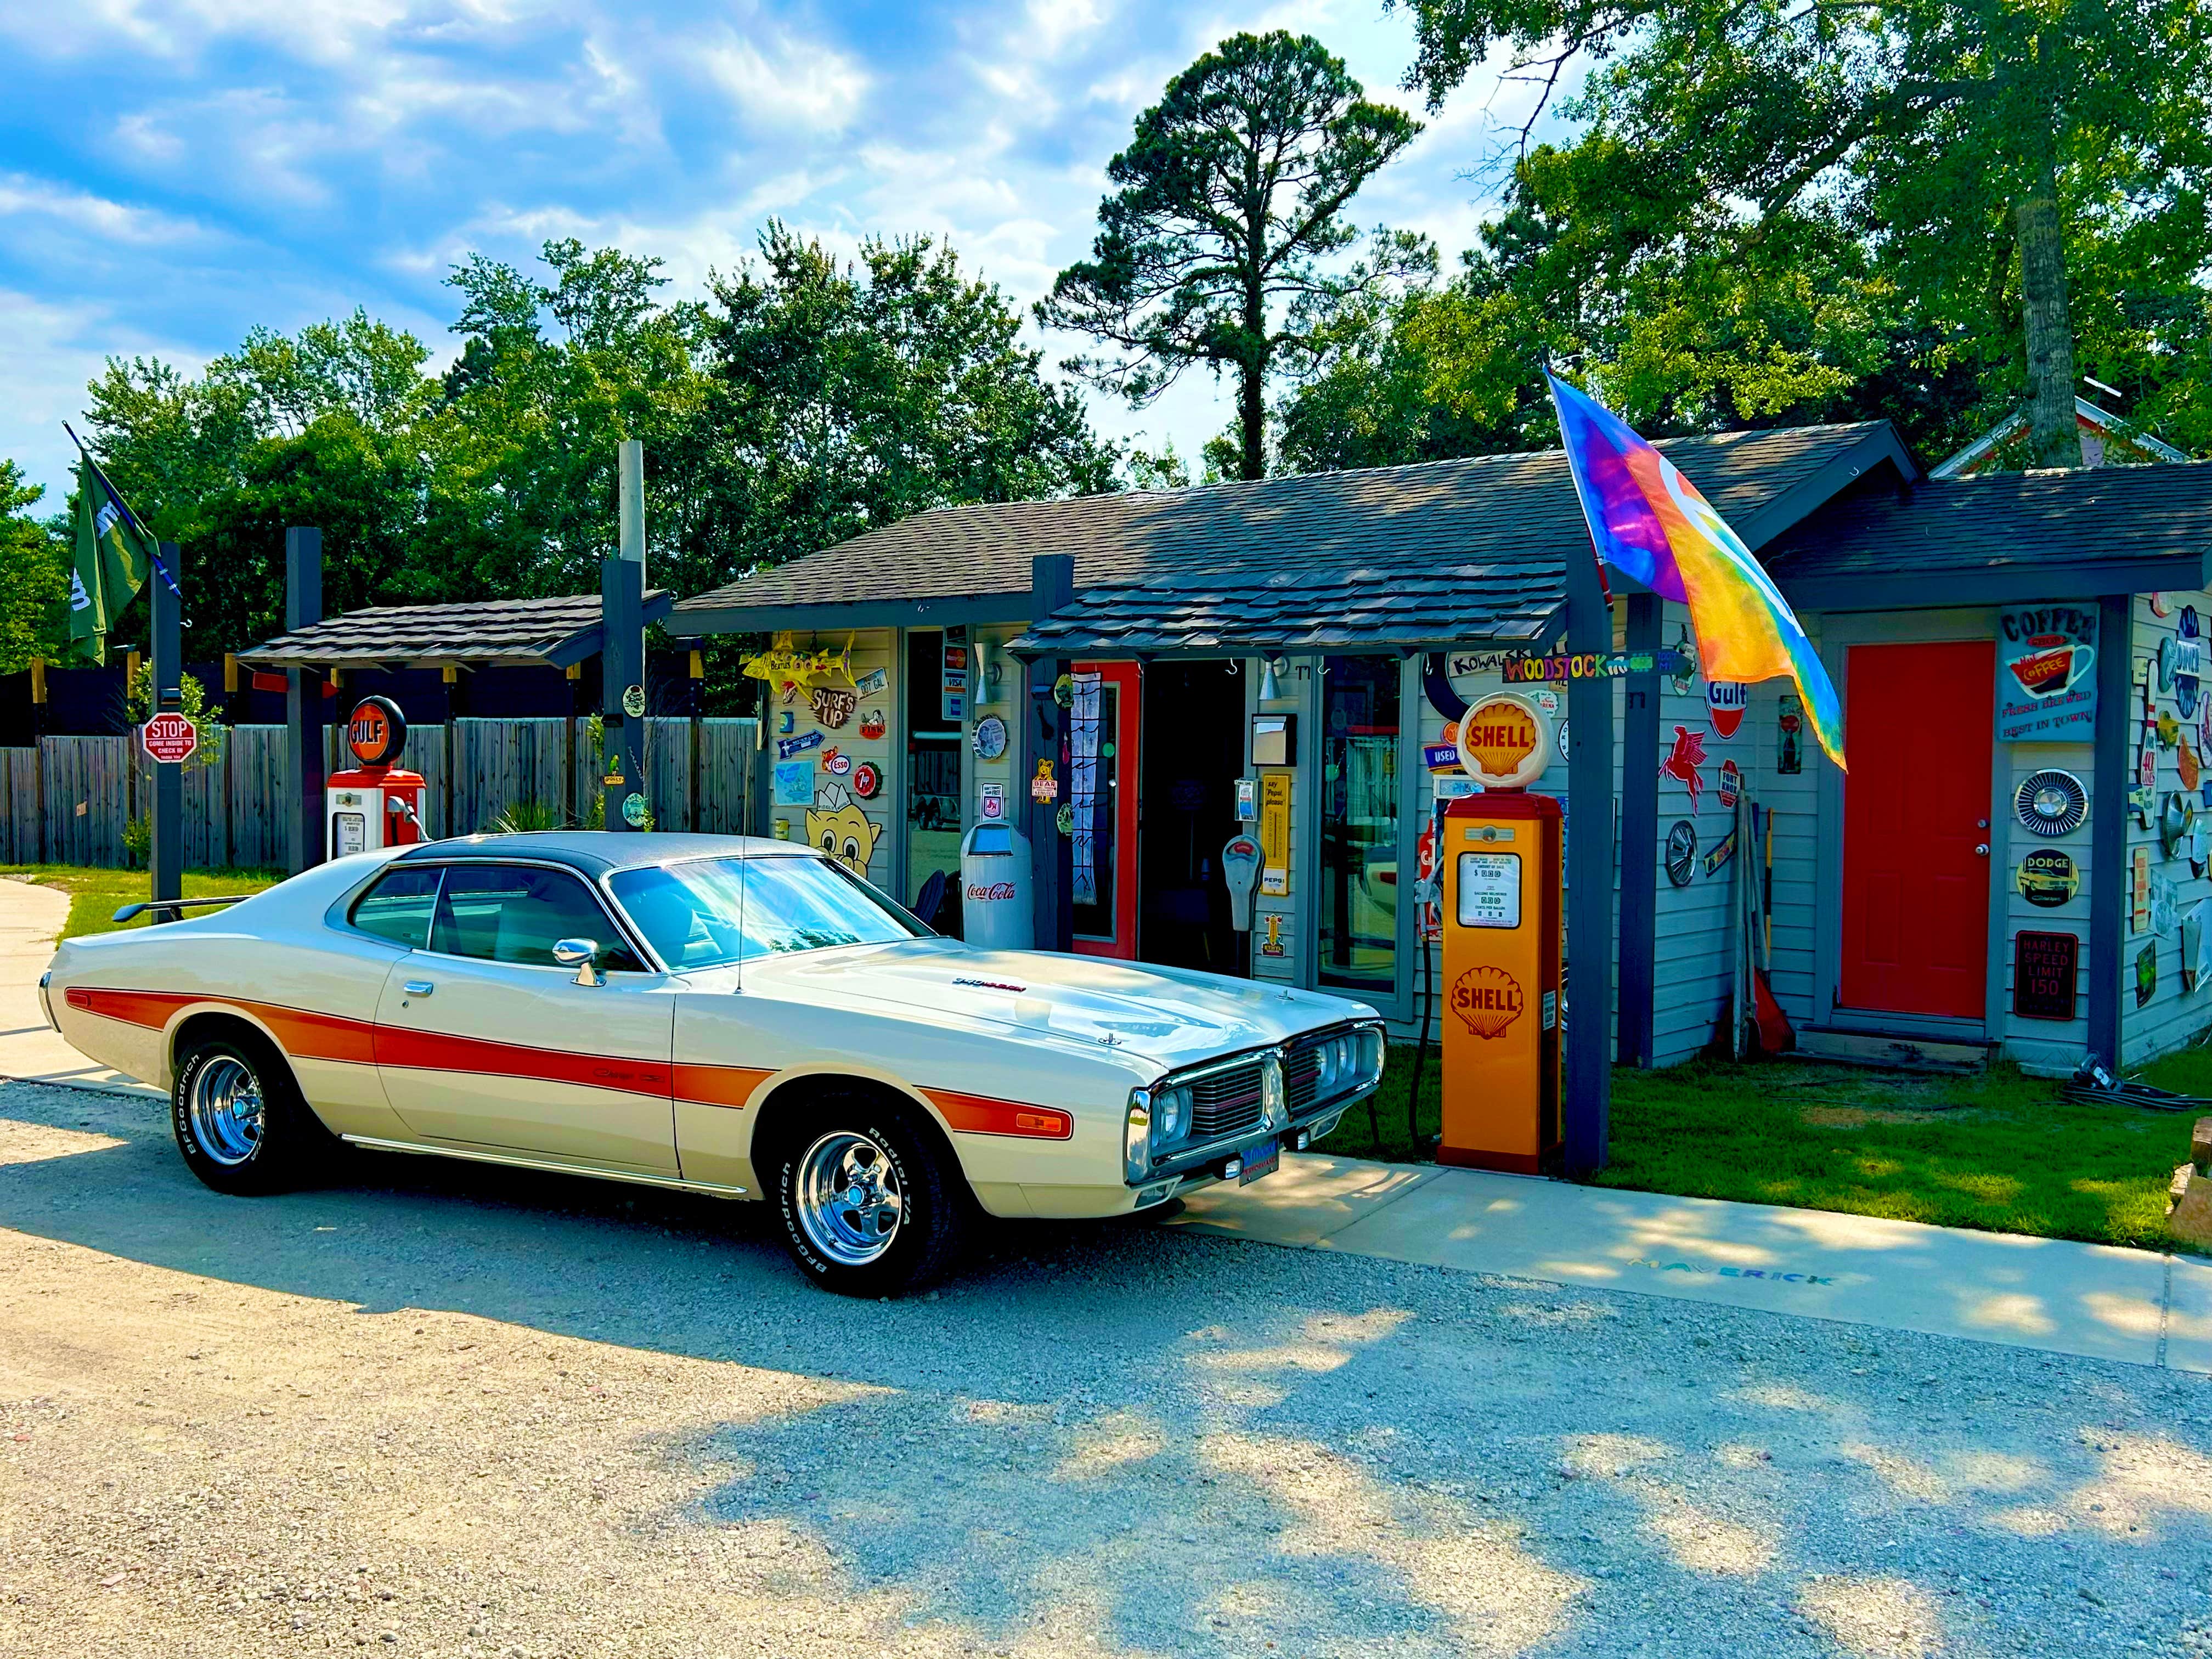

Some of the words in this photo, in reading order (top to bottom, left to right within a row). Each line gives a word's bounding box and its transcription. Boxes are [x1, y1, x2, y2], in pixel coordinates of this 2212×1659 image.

[2002, 608, 2096, 644] COFFEE
[1506, 653, 1609, 681] WOODSTOCK
[949, 679, 962, 687] VISA
[814, 690, 854, 711] SURF'S
[1709, 681, 1746, 704] Gulf
[823, 710, 843, 728] UP
[151, 721, 187, 738] STOP
[351, 720, 385, 744] GULF
[861, 724, 884, 734] FISK
[1470, 726, 1530, 747] SHELL
[2003, 723, 2033, 738] BEST
[2036, 718, 2051, 730] IN
[1435, 750, 1455, 763] USED
[1723, 772, 1737, 783] FORT
[1722, 781, 1737, 794] KNOX
[2027, 857, 2068, 868] DODGE
[2023, 940, 2069, 952] HARLEY
[2025, 952, 2068, 966] SPEED
[2028, 966, 2063, 978] LIMIT
[2032, 979, 2059, 995] 150
[1457, 987, 1517, 1012] SHELL
[179, 1054, 200, 1154] BFGoodrich
[780, 1162, 827, 1273] BFGoodrich
